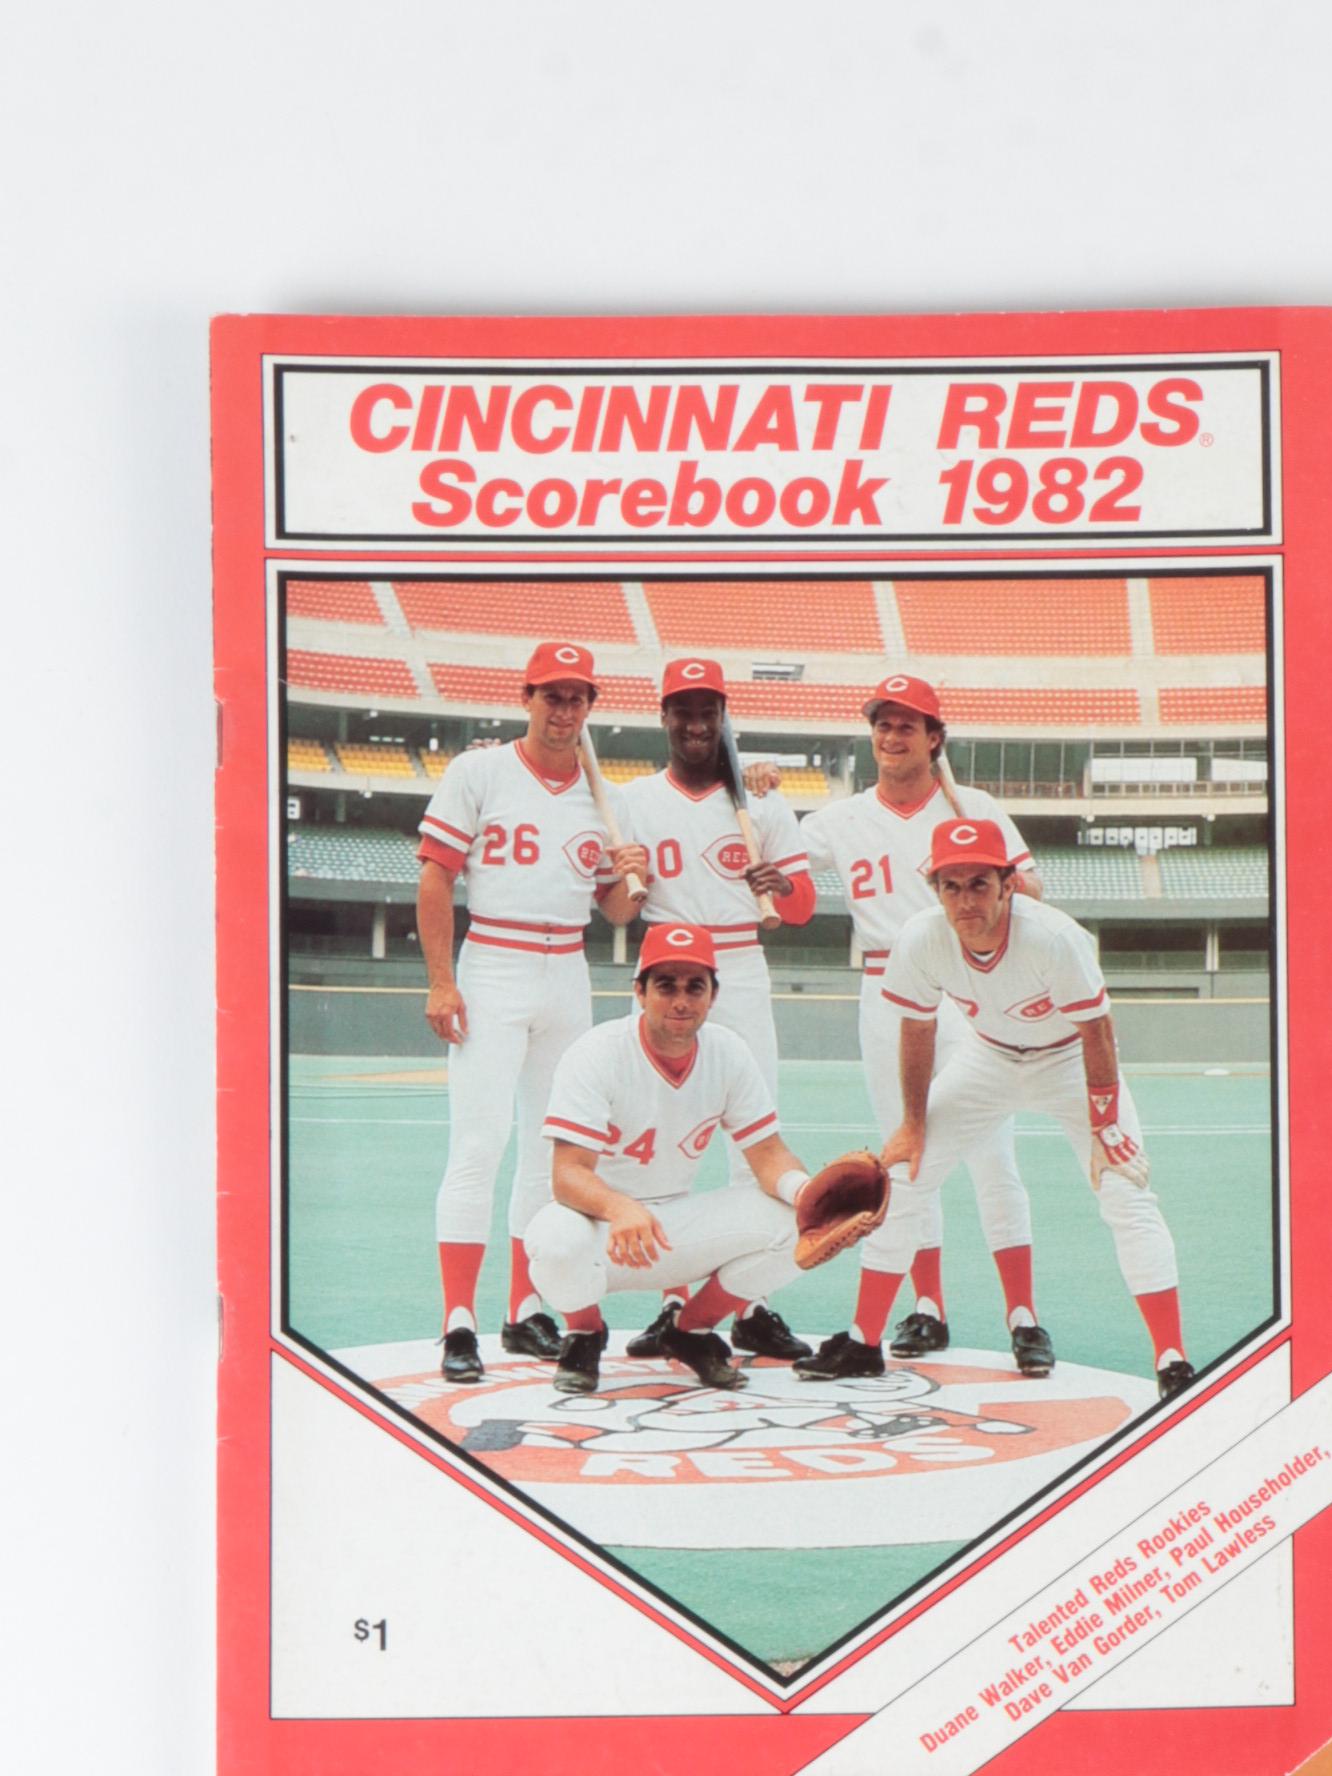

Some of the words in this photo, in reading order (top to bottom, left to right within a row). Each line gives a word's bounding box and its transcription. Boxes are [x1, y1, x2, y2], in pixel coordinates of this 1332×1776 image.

[349, 383, 889, 452] CINCINNATI
[412, 459, 887, 528] Scorebook
[939, 456, 1145, 525] 1982
[481, 823, 541, 865] 26
[850, 854, 893, 900] 21
[579, 1436, 994, 1478] REDS
[918, 1704, 979, 1754] Duane
[978, 1653, 1053, 1709] Walker,
[1050, 1612, 1104, 1657] Eddie
[1104, 1567, 1172, 1617] Milner,
[1169, 1528, 1215, 1568] Paul
[1213, 1442, 1332, 1533] Householder,
[1008, 1588, 1090, 1655] Talented
[1090, 1555, 1138, 1596] Reds
[1136, 1499, 1213, 1560] Rookies
[354, 1616, 387, 1651] $1
[1004, 1683, 1053, 1723] Dave
[1052, 1652, 1093, 1687] Van
[1093, 1604, 1163, 1657] Gorder,
[1160, 1571, 1202, 1604] Tom
[1201, 1511, 1277, 1575] Lawless
